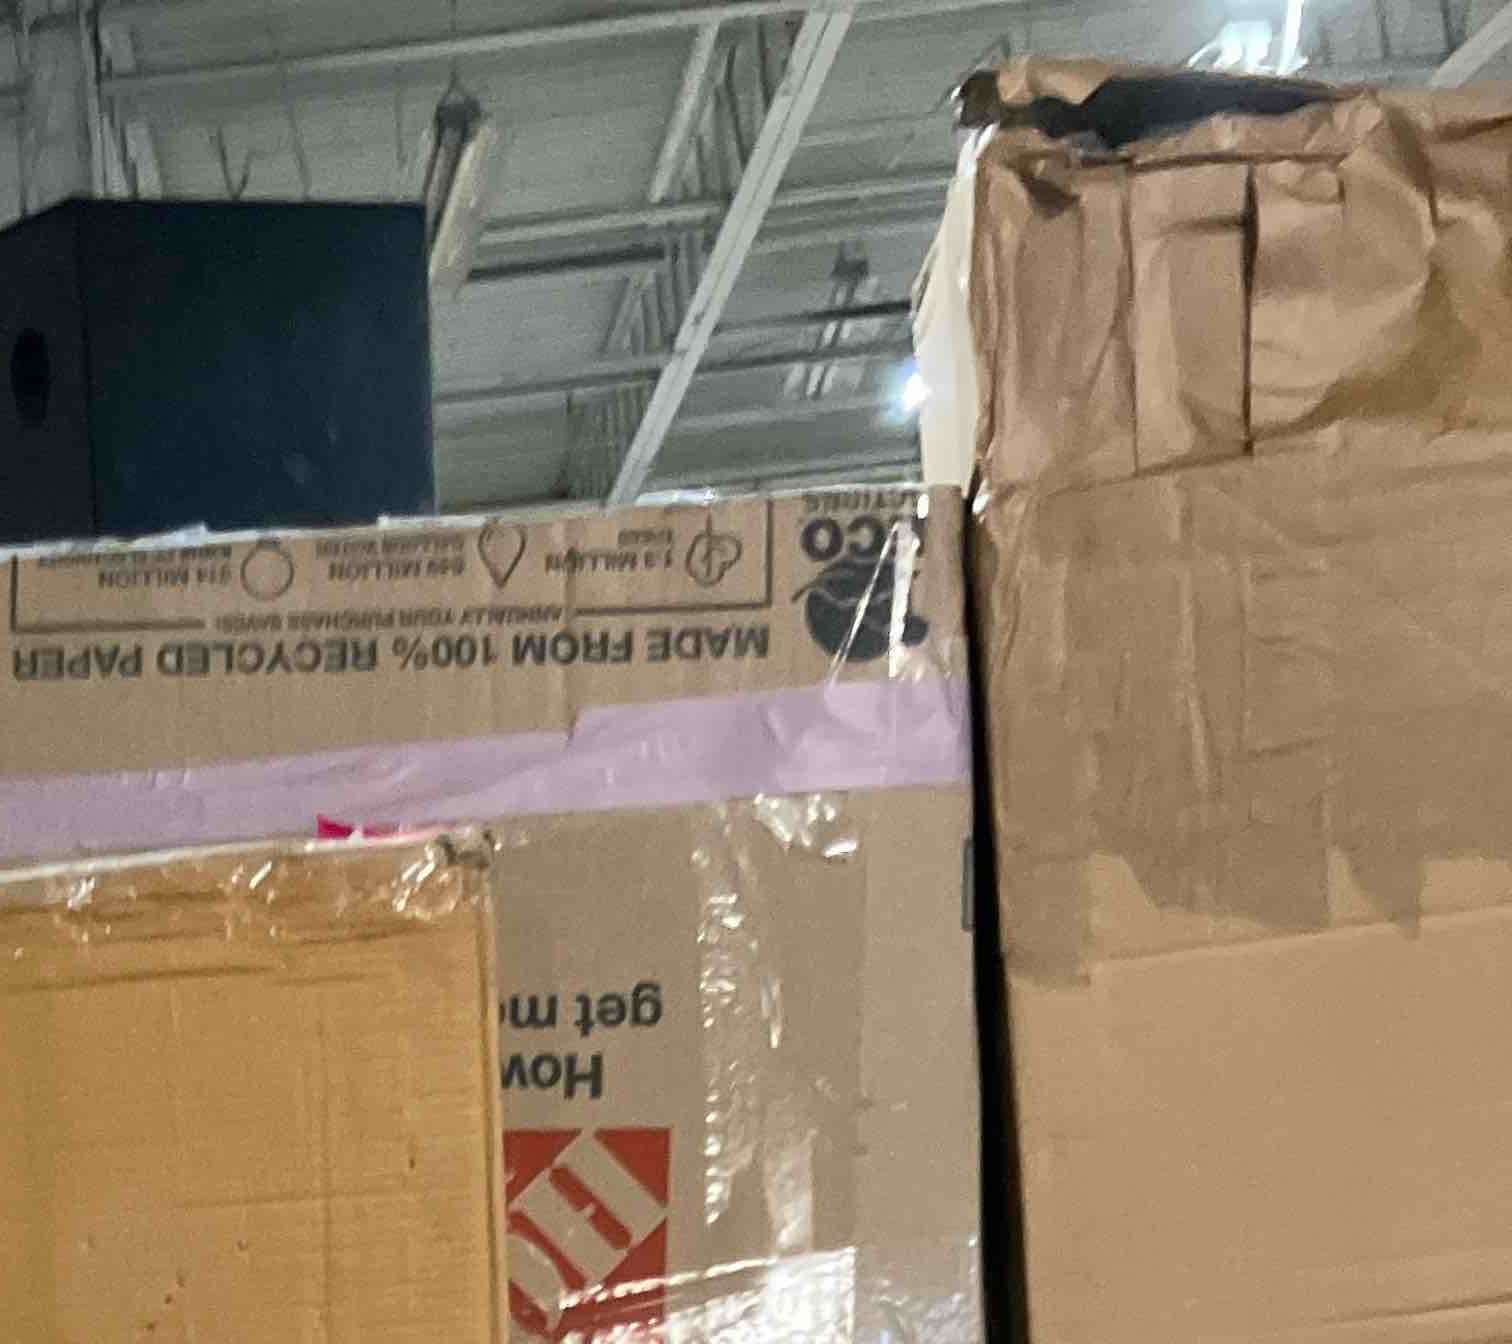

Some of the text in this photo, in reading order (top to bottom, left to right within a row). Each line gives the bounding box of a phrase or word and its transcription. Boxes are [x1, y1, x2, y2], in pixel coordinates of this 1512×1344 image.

[12, 624, 771, 681] MADE FROM 100% RECYCLED PAPER
[499, 980, 663, 1038] get m
